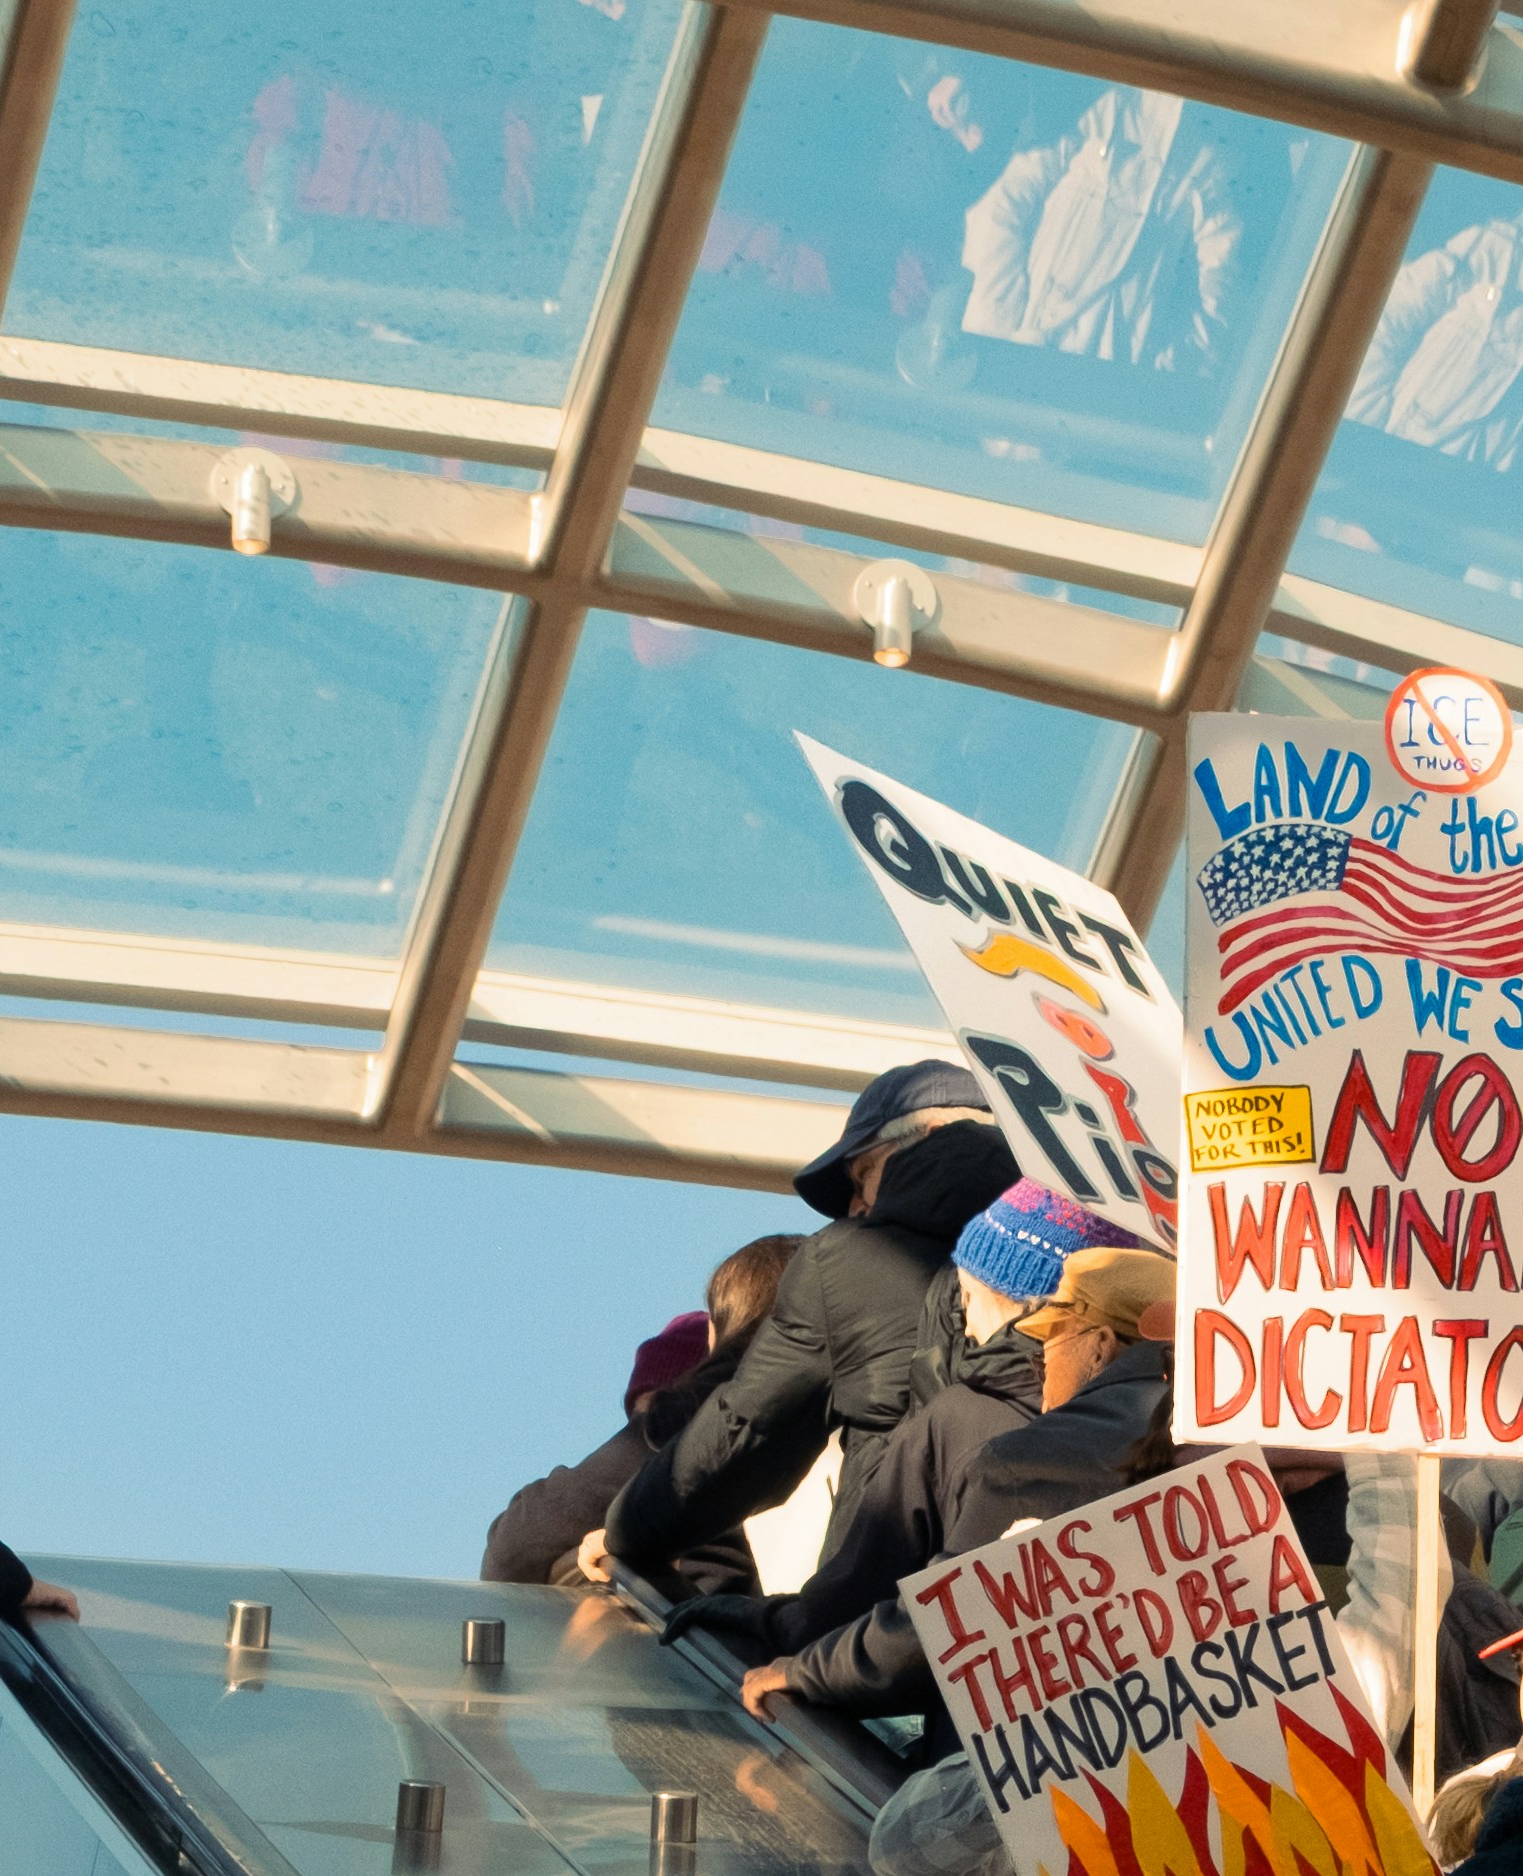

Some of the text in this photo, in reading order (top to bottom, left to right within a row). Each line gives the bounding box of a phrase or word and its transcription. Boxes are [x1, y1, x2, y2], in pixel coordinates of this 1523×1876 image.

[1399, 695, 1490, 748] ICE
[1412, 755, 1483, 773] THUGS
[1193, 741, 1372, 842] LAND
[1370, 791, 1428, 851] of
[833, 776, 1155, 1001] QUIET
[1204, 955, 1383, 1082] UNITED
[1404, 958, 1484, 1045] WE
[1193, 1132, 1306, 1162] FOR THIS!
[1195, 1092, 1285, 1119] NOBODY
[1201, 1116, 1285, 1141] VOTED
[1319, 1048, 1523, 1183] NO
[915, 1458, 1282, 1664] I WAS TOLD
[947, 1534, 1318, 1734] THERE'D BE A
[970, 1600, 1340, 1814] HANDBASKET
